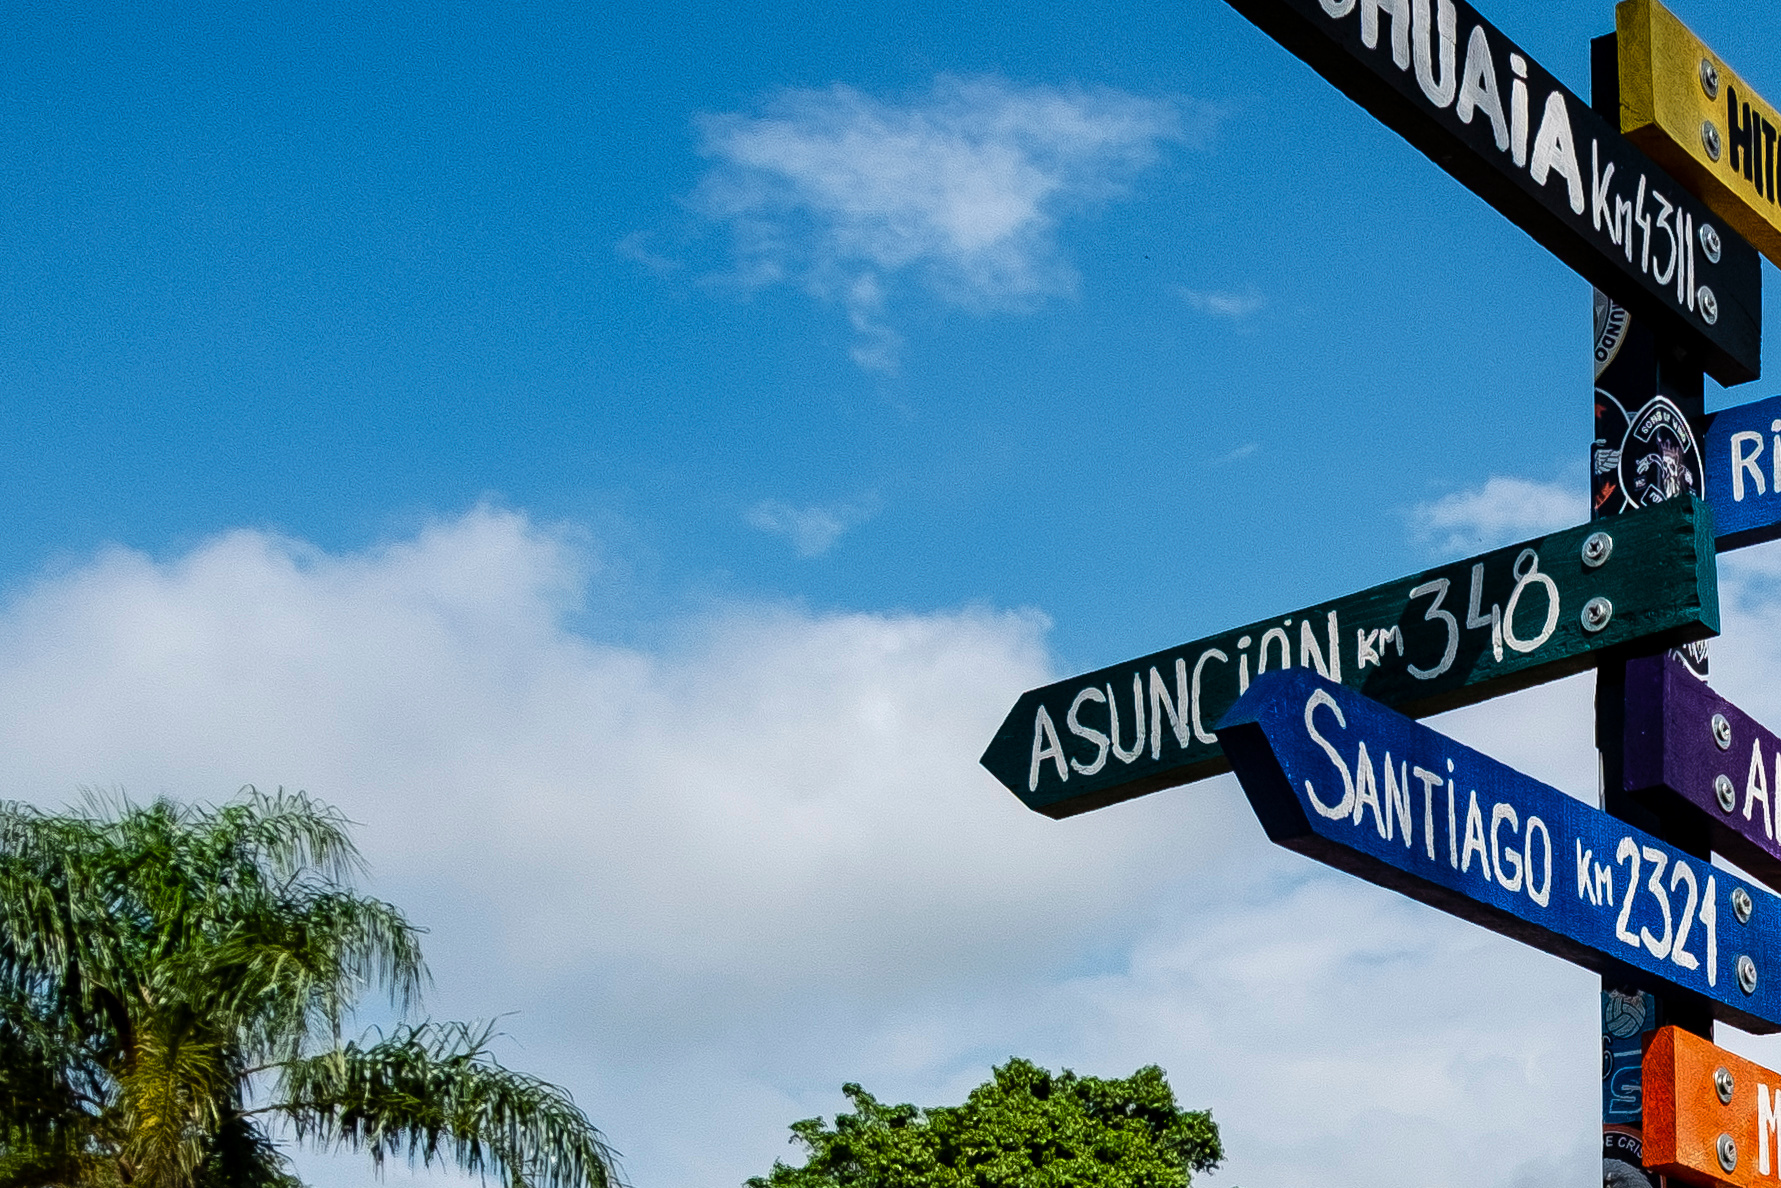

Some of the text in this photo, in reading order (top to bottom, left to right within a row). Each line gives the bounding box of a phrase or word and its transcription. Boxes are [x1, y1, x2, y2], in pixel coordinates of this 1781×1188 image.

[1595, 299, 1627, 363] UNDO
[1407, 548, 1560, 680] 348
[1615, 836, 1717, 988] 2321
